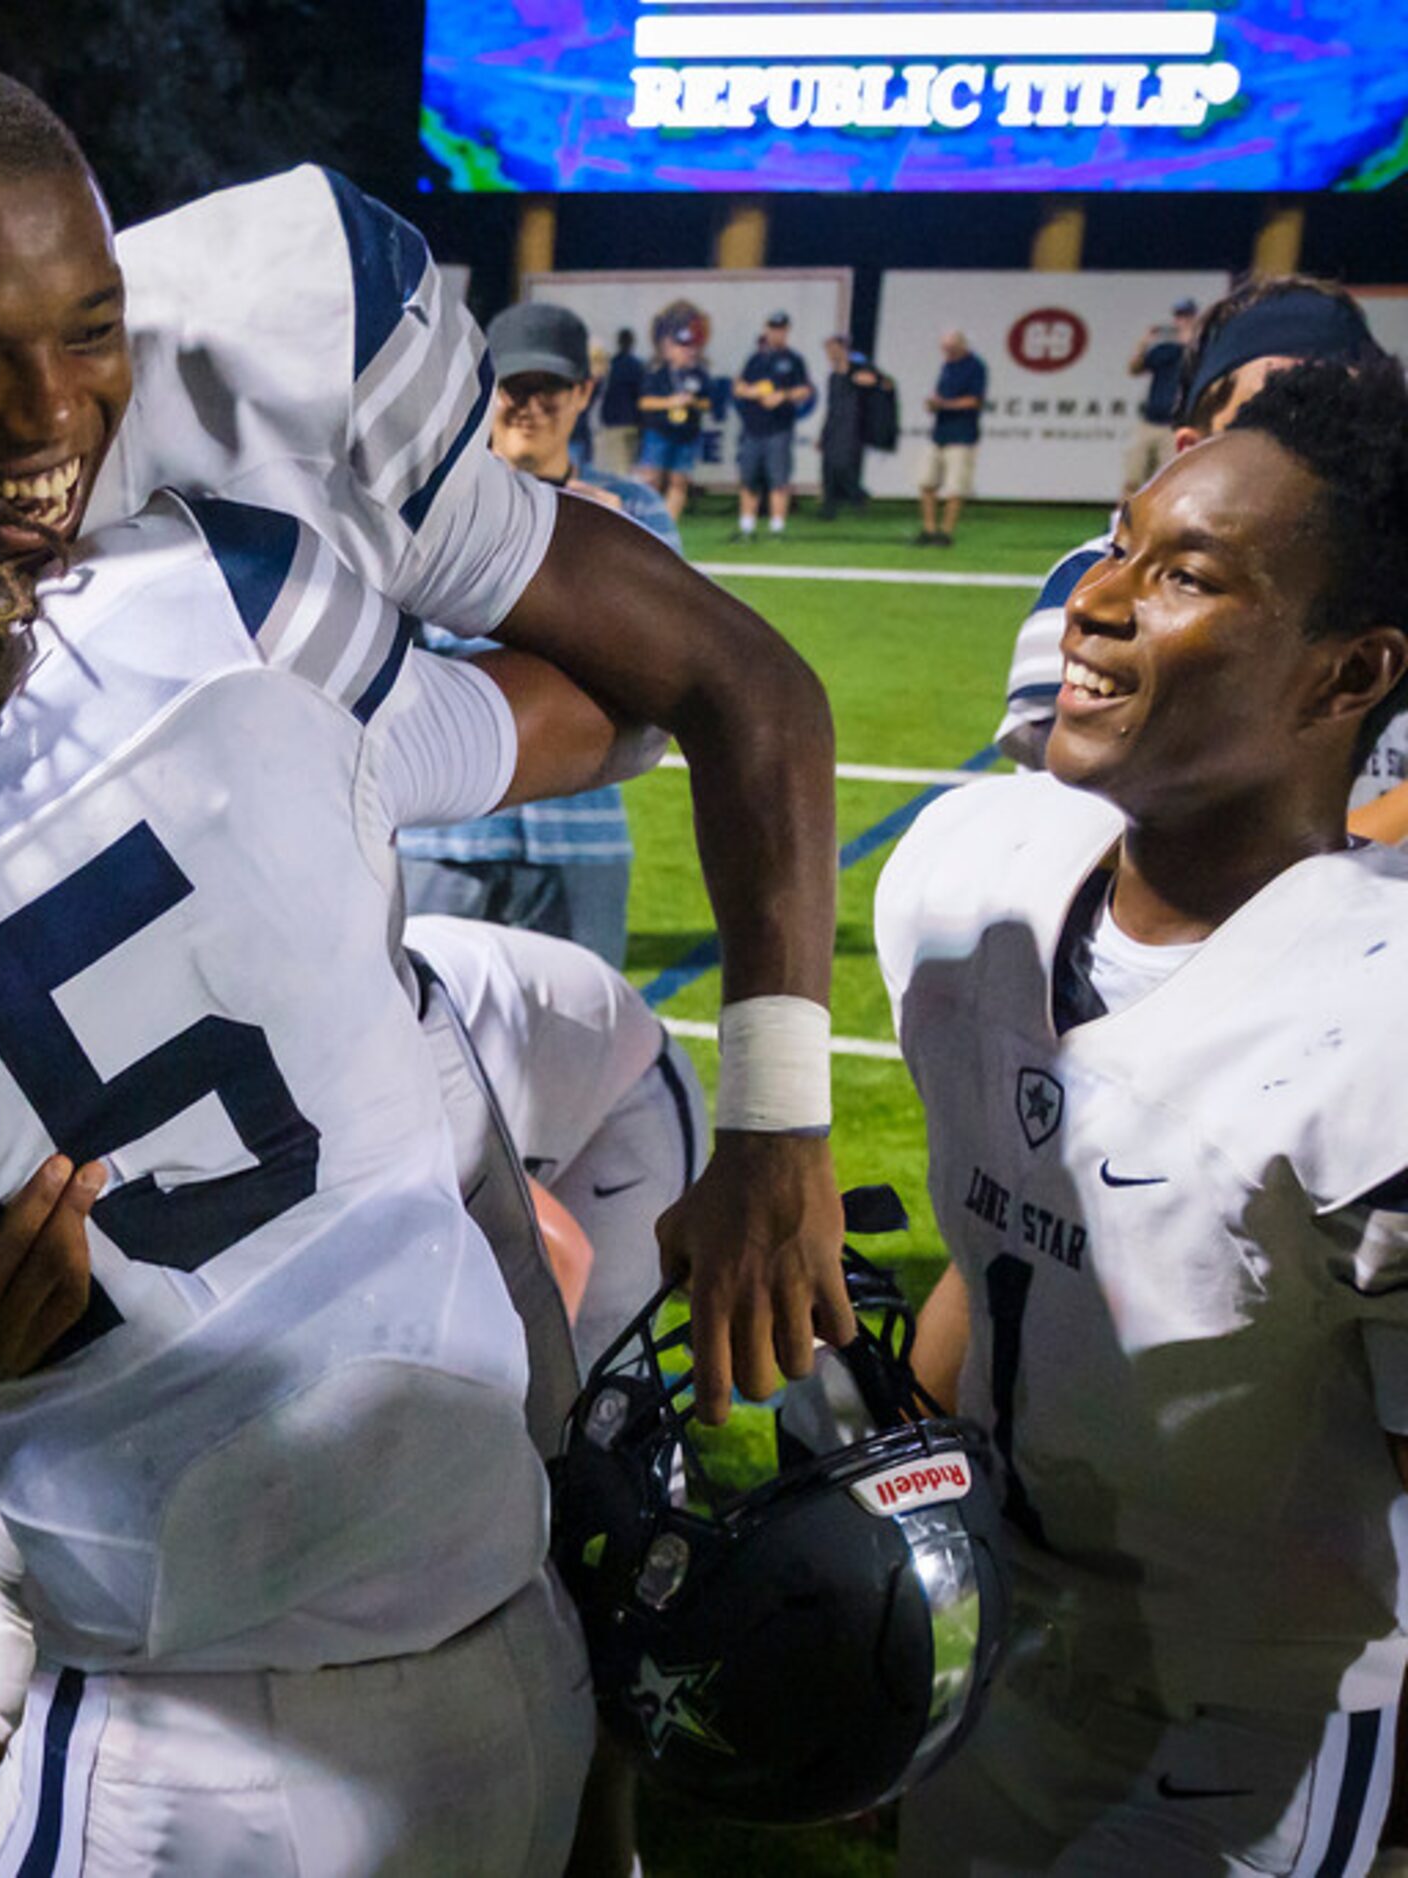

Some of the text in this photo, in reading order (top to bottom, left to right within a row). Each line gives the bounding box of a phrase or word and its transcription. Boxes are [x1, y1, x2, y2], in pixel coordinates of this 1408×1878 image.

[626, 65, 986, 128] REPUBLIC
[964, 1166, 1088, 1273] LONE STAR
[876, 1464, 967, 1507] Riddell
